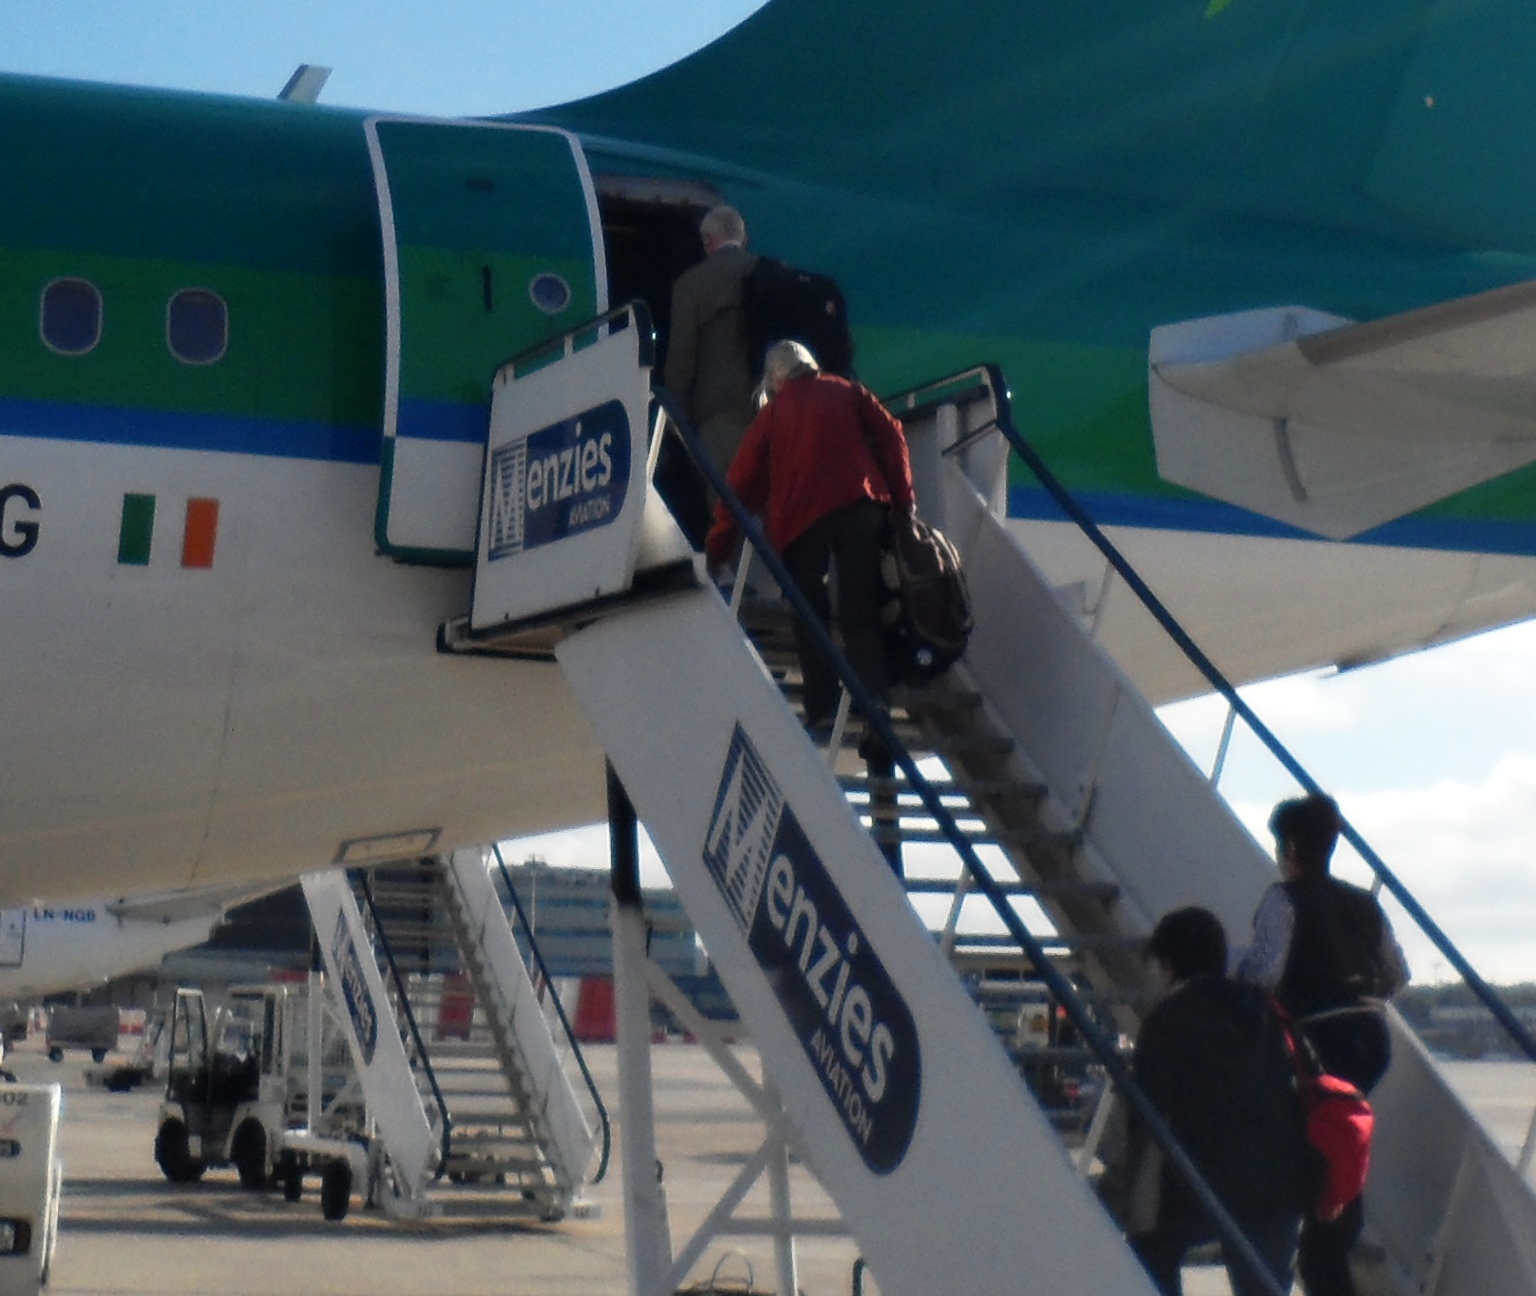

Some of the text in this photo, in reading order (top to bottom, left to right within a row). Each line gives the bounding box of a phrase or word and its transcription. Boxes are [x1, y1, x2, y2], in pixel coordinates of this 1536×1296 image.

[489, 421, 612, 557] Menzies
[707, 744, 895, 1103] Menzies
[810, 1028, 874, 1144] AVIATION
